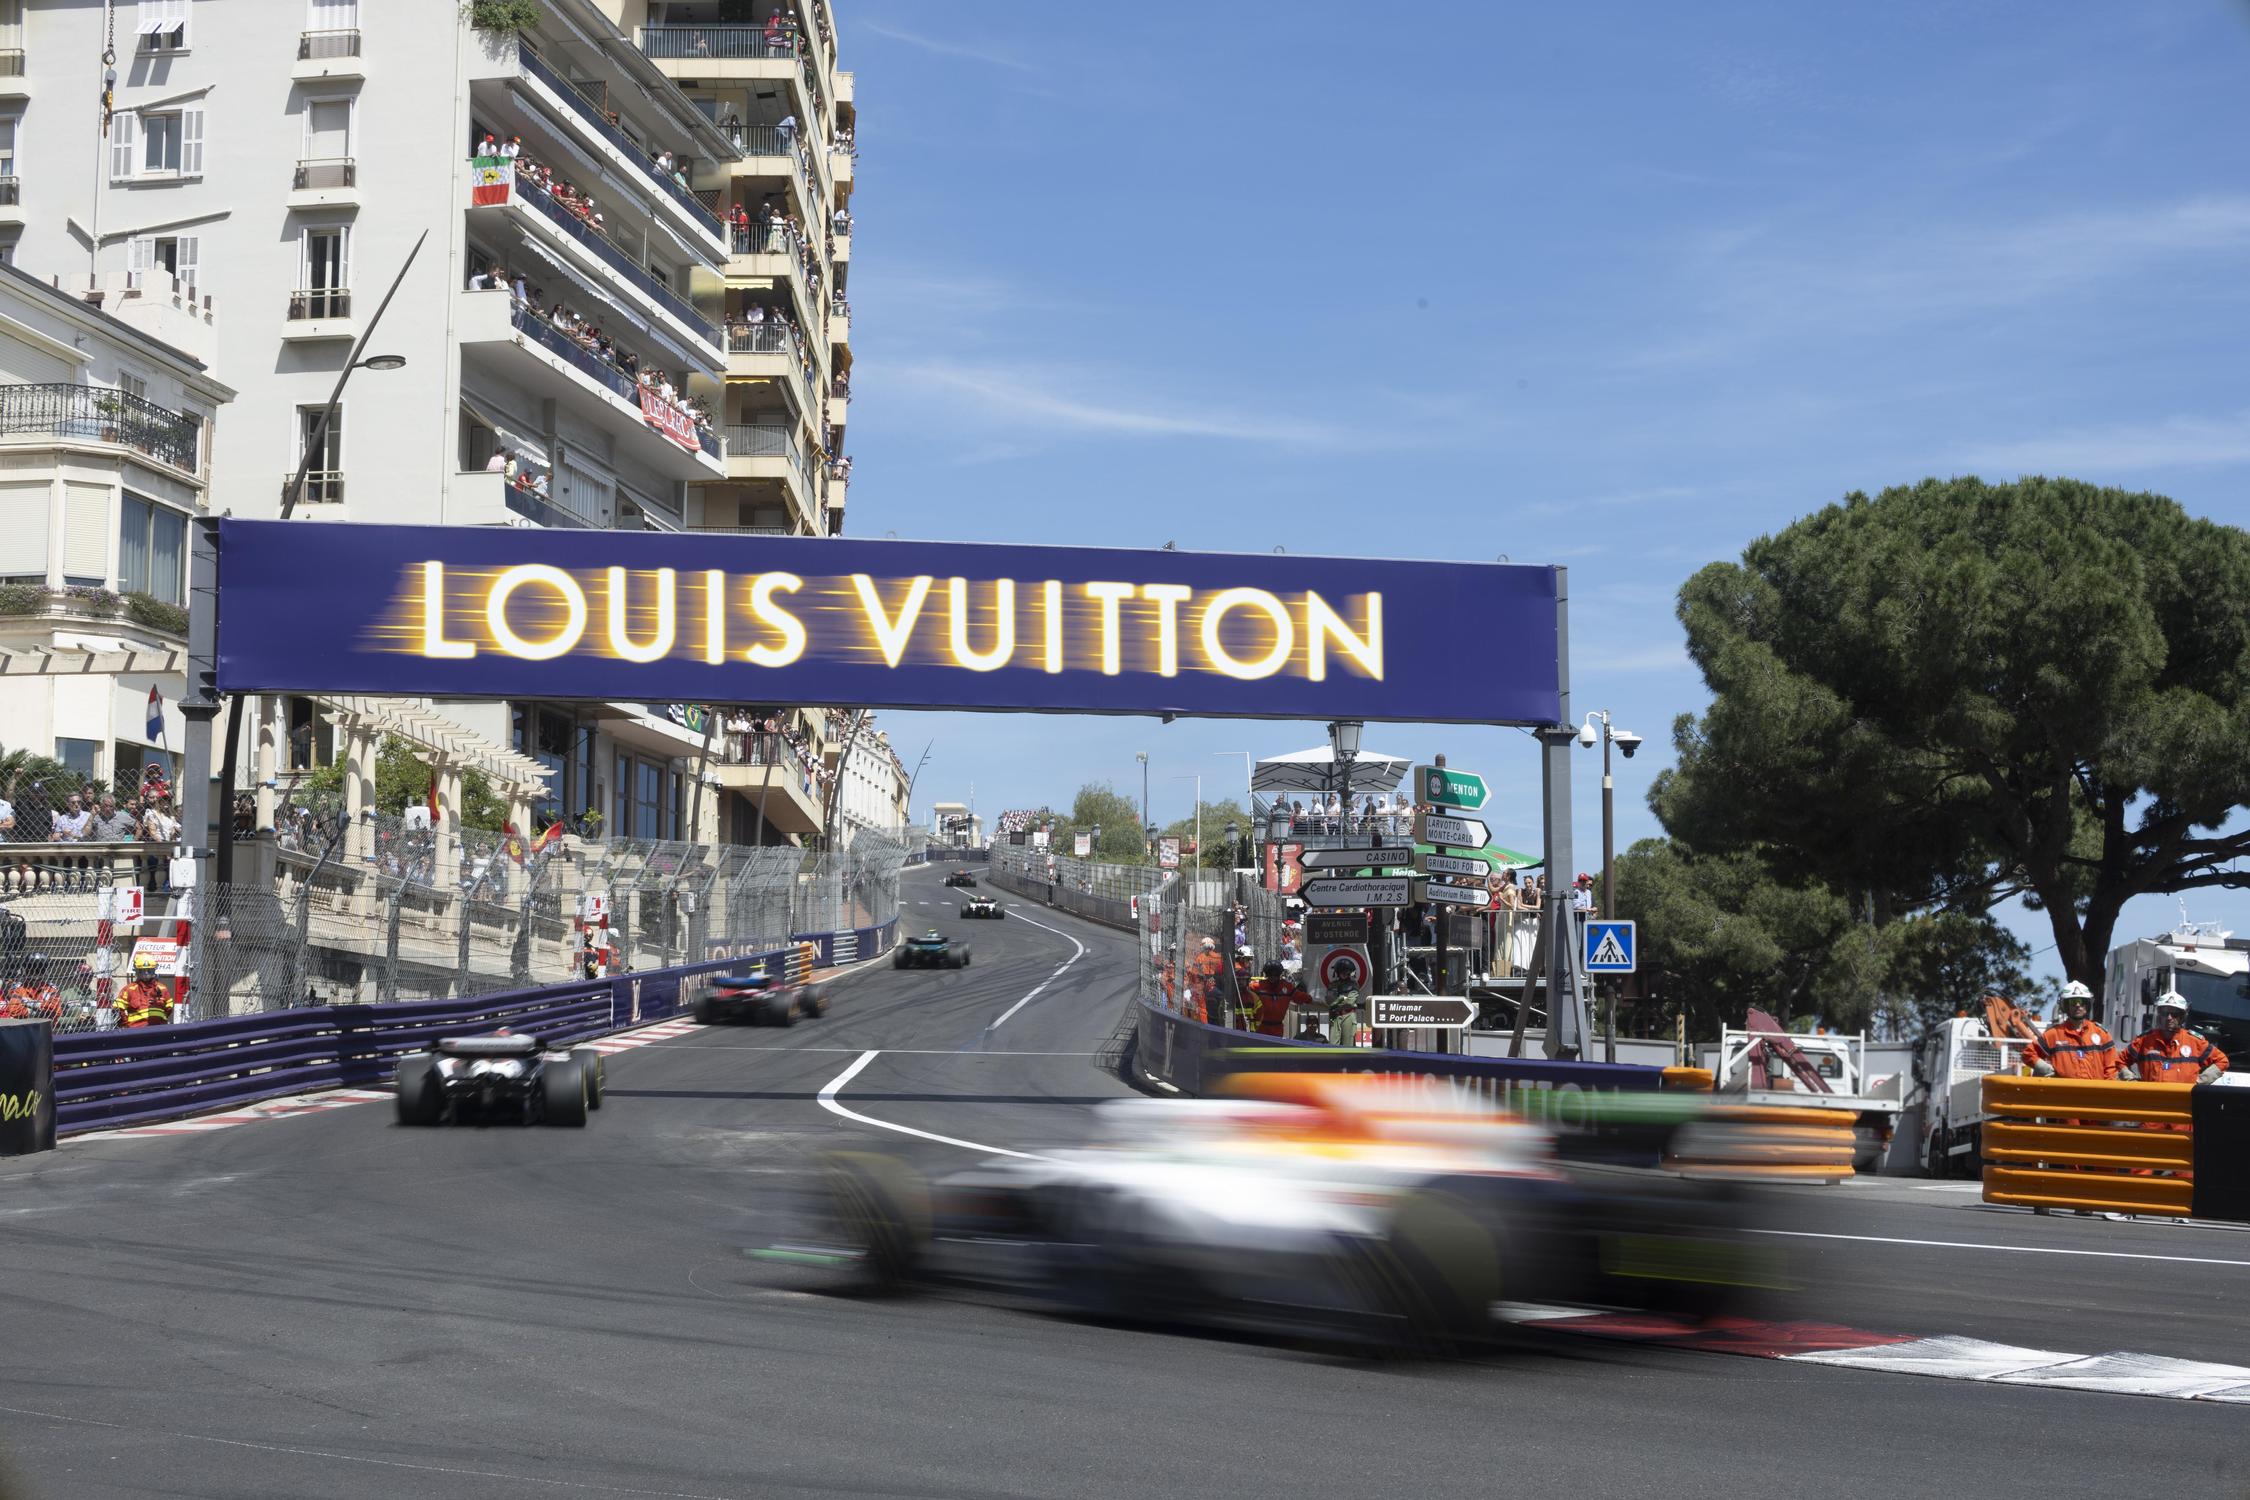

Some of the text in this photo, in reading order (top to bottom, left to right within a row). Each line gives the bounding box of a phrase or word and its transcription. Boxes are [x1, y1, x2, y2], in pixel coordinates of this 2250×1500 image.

[423, 560, 1384, 682] LOUIS VUITTON
[1447, 782, 1479, 797] MENTON
[1428, 818, 1461, 831] LARVOTTO
[1428, 828, 1473, 843] MONTE-CARLO
[1366, 852, 1405, 862] CASINO
[1428, 858, 1484, 873] GRIMALDI FORUM
[1311, 882, 1406, 892] Centre Cardiothoracique
[1366, 893, 1406, 902] I.M.2.S.
[1428, 888, 1458, 899] Auditorium
[1460, 890, 1479, 901] Rainier
[1321, 920, 1352, 928] AVENUE
[1314, 930, 1360, 938] D'OSTENDE
[1389, 1003, 1422, 1011] Miramar
[1389, 1014, 1434, 1022] Port Palace
